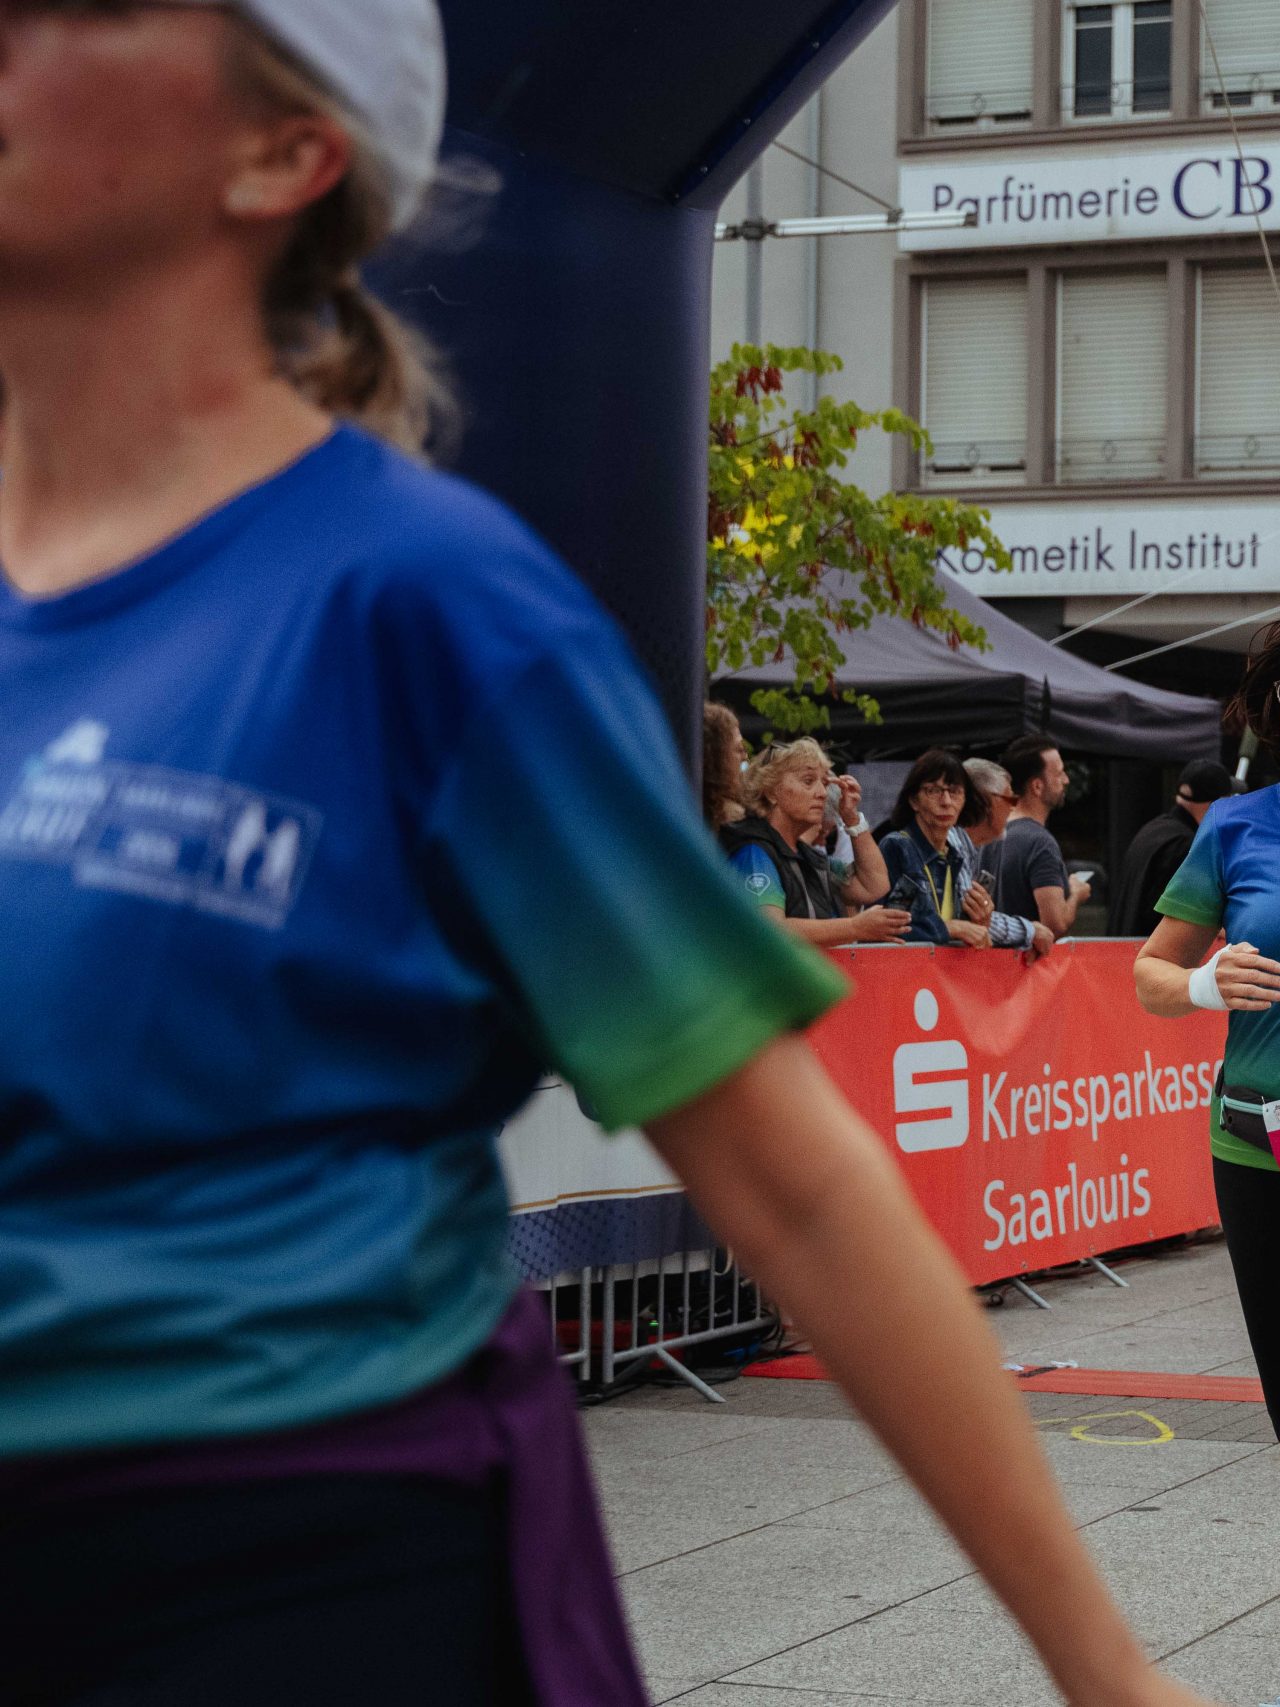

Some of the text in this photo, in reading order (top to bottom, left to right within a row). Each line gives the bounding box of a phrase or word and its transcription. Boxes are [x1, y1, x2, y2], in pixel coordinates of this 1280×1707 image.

[934, 155, 1274, 226] Parfümerie CB
[1129, 528, 1261, 571] Institut
[983, 1154, 1151, 1251] Saarlouis
